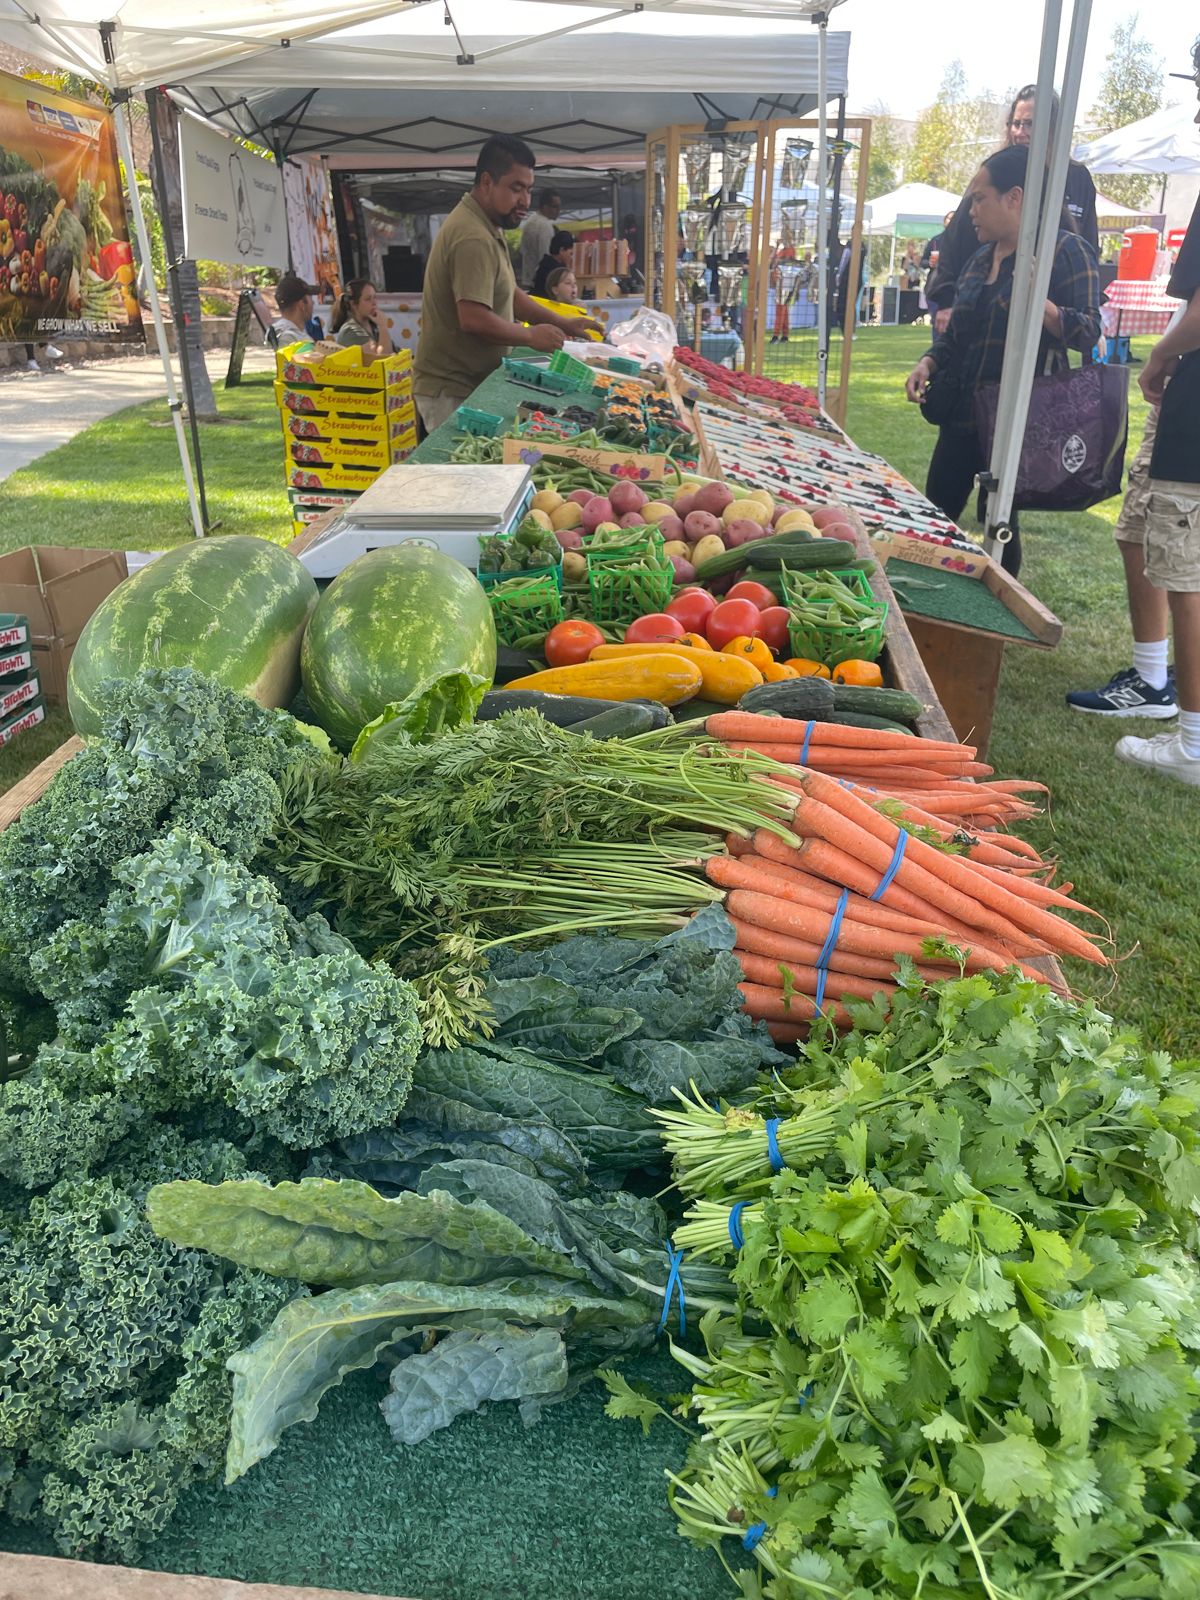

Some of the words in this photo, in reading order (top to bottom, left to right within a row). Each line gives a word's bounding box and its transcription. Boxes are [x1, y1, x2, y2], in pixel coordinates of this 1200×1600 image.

[46, 318, 64, 331] GROW
[64, 319, 84, 332] WHAT
[84, 320, 98, 333] WE
[98, 320, 121, 333] SELL
[316, 364, 379, 379] Strawberries
[318, 391, 379, 405] Strawberries
[321, 417, 383, 431] Strawberries
[324, 444, 385, 458] Strawberries
